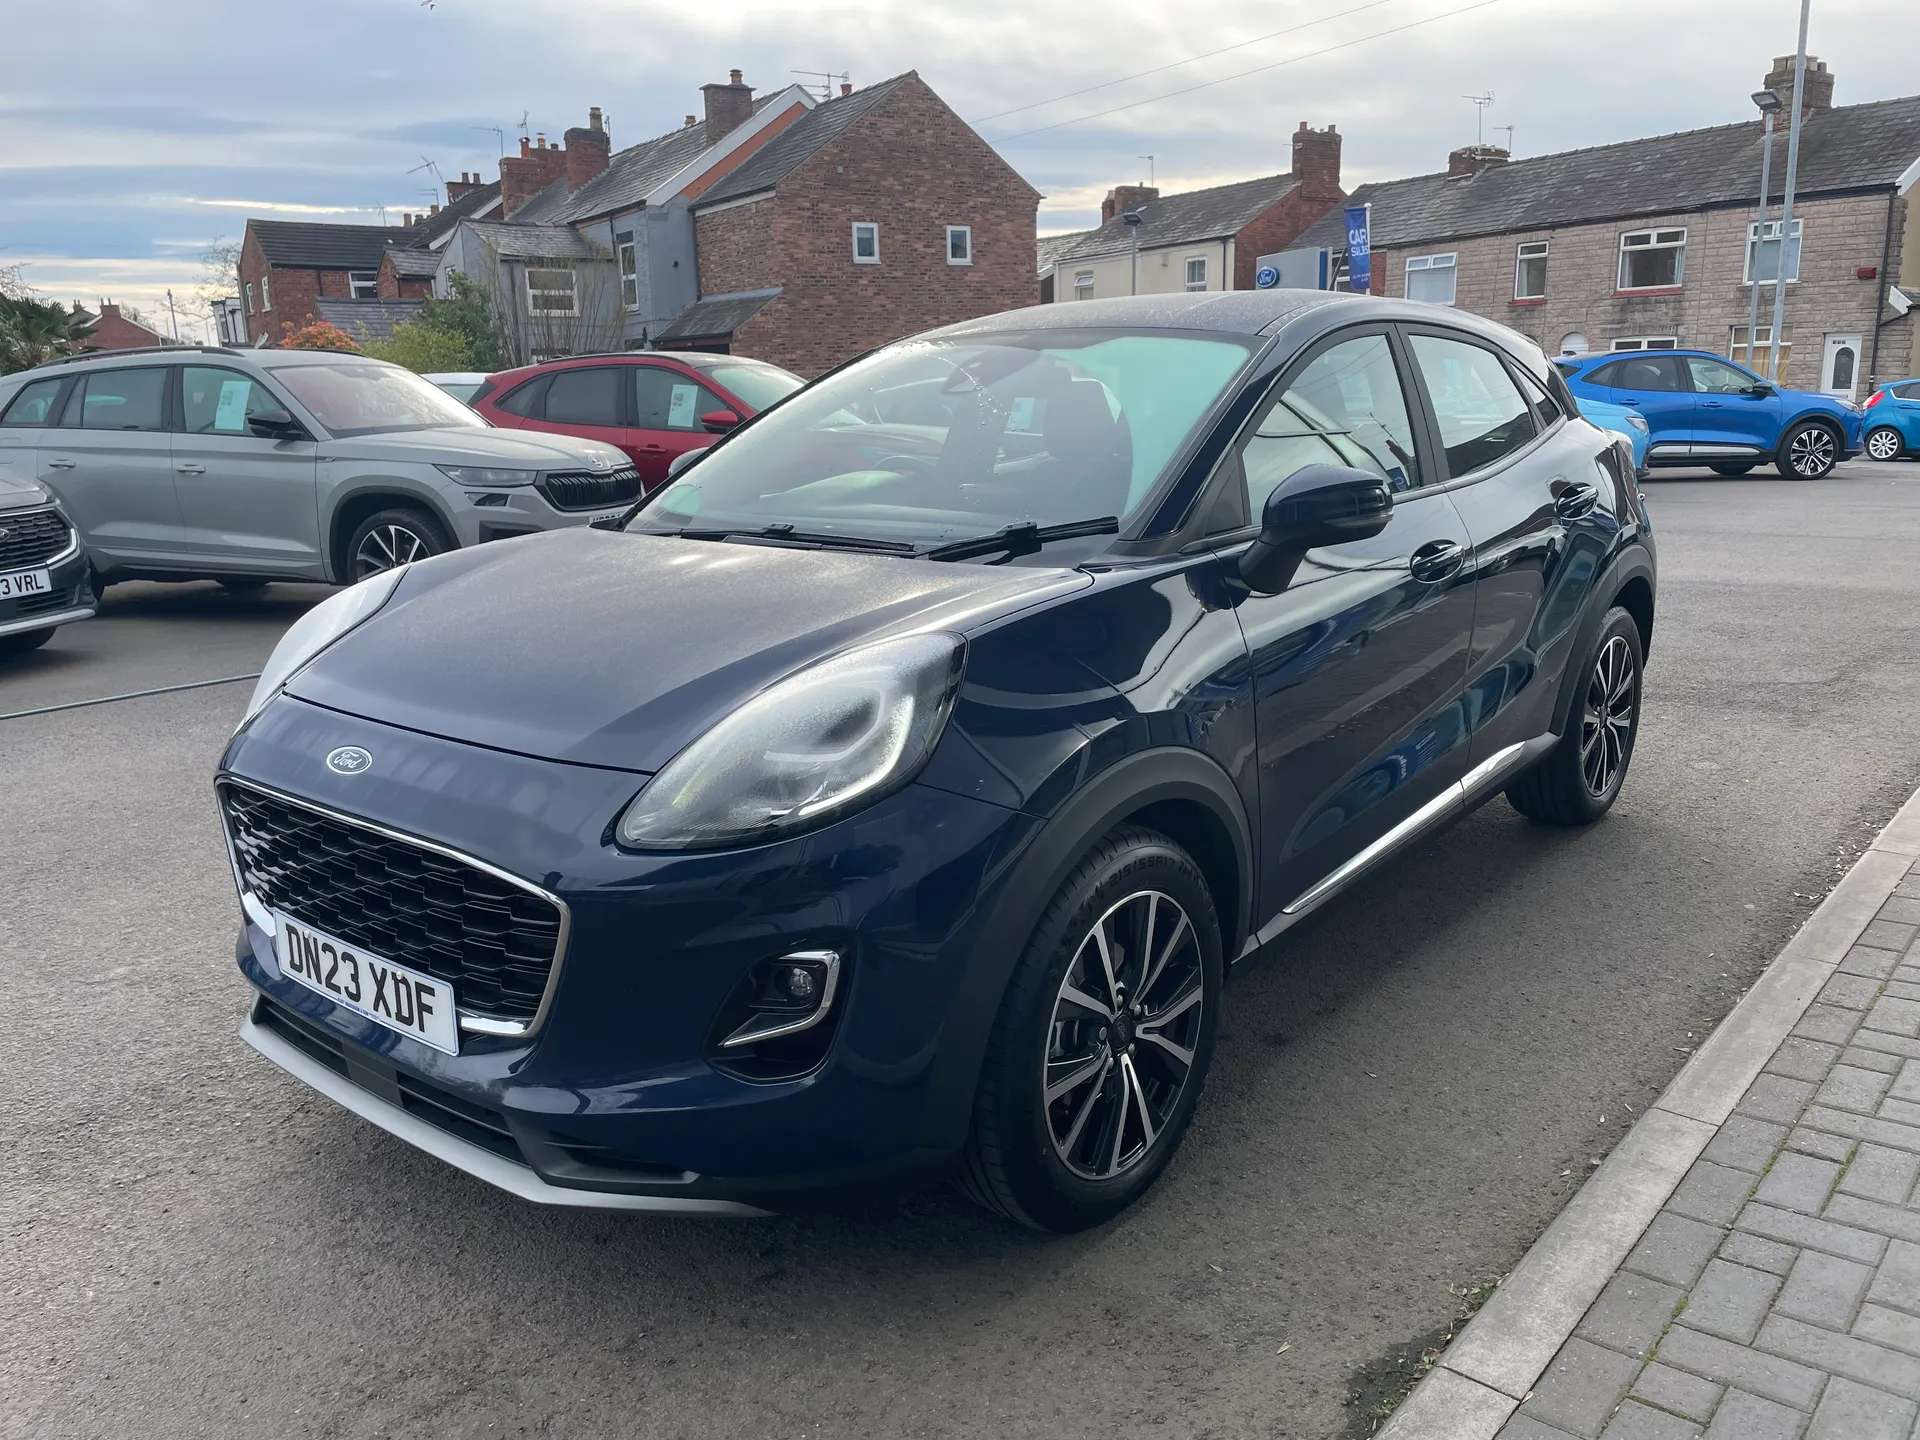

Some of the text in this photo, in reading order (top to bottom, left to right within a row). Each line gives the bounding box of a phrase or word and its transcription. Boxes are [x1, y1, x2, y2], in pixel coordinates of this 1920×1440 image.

[1349, 228, 1368, 245] CAR
[14, 573, 44, 593] VRL
[333, 751, 362, 769] Ford
[286, 923, 435, 1033] DN23 XDF
